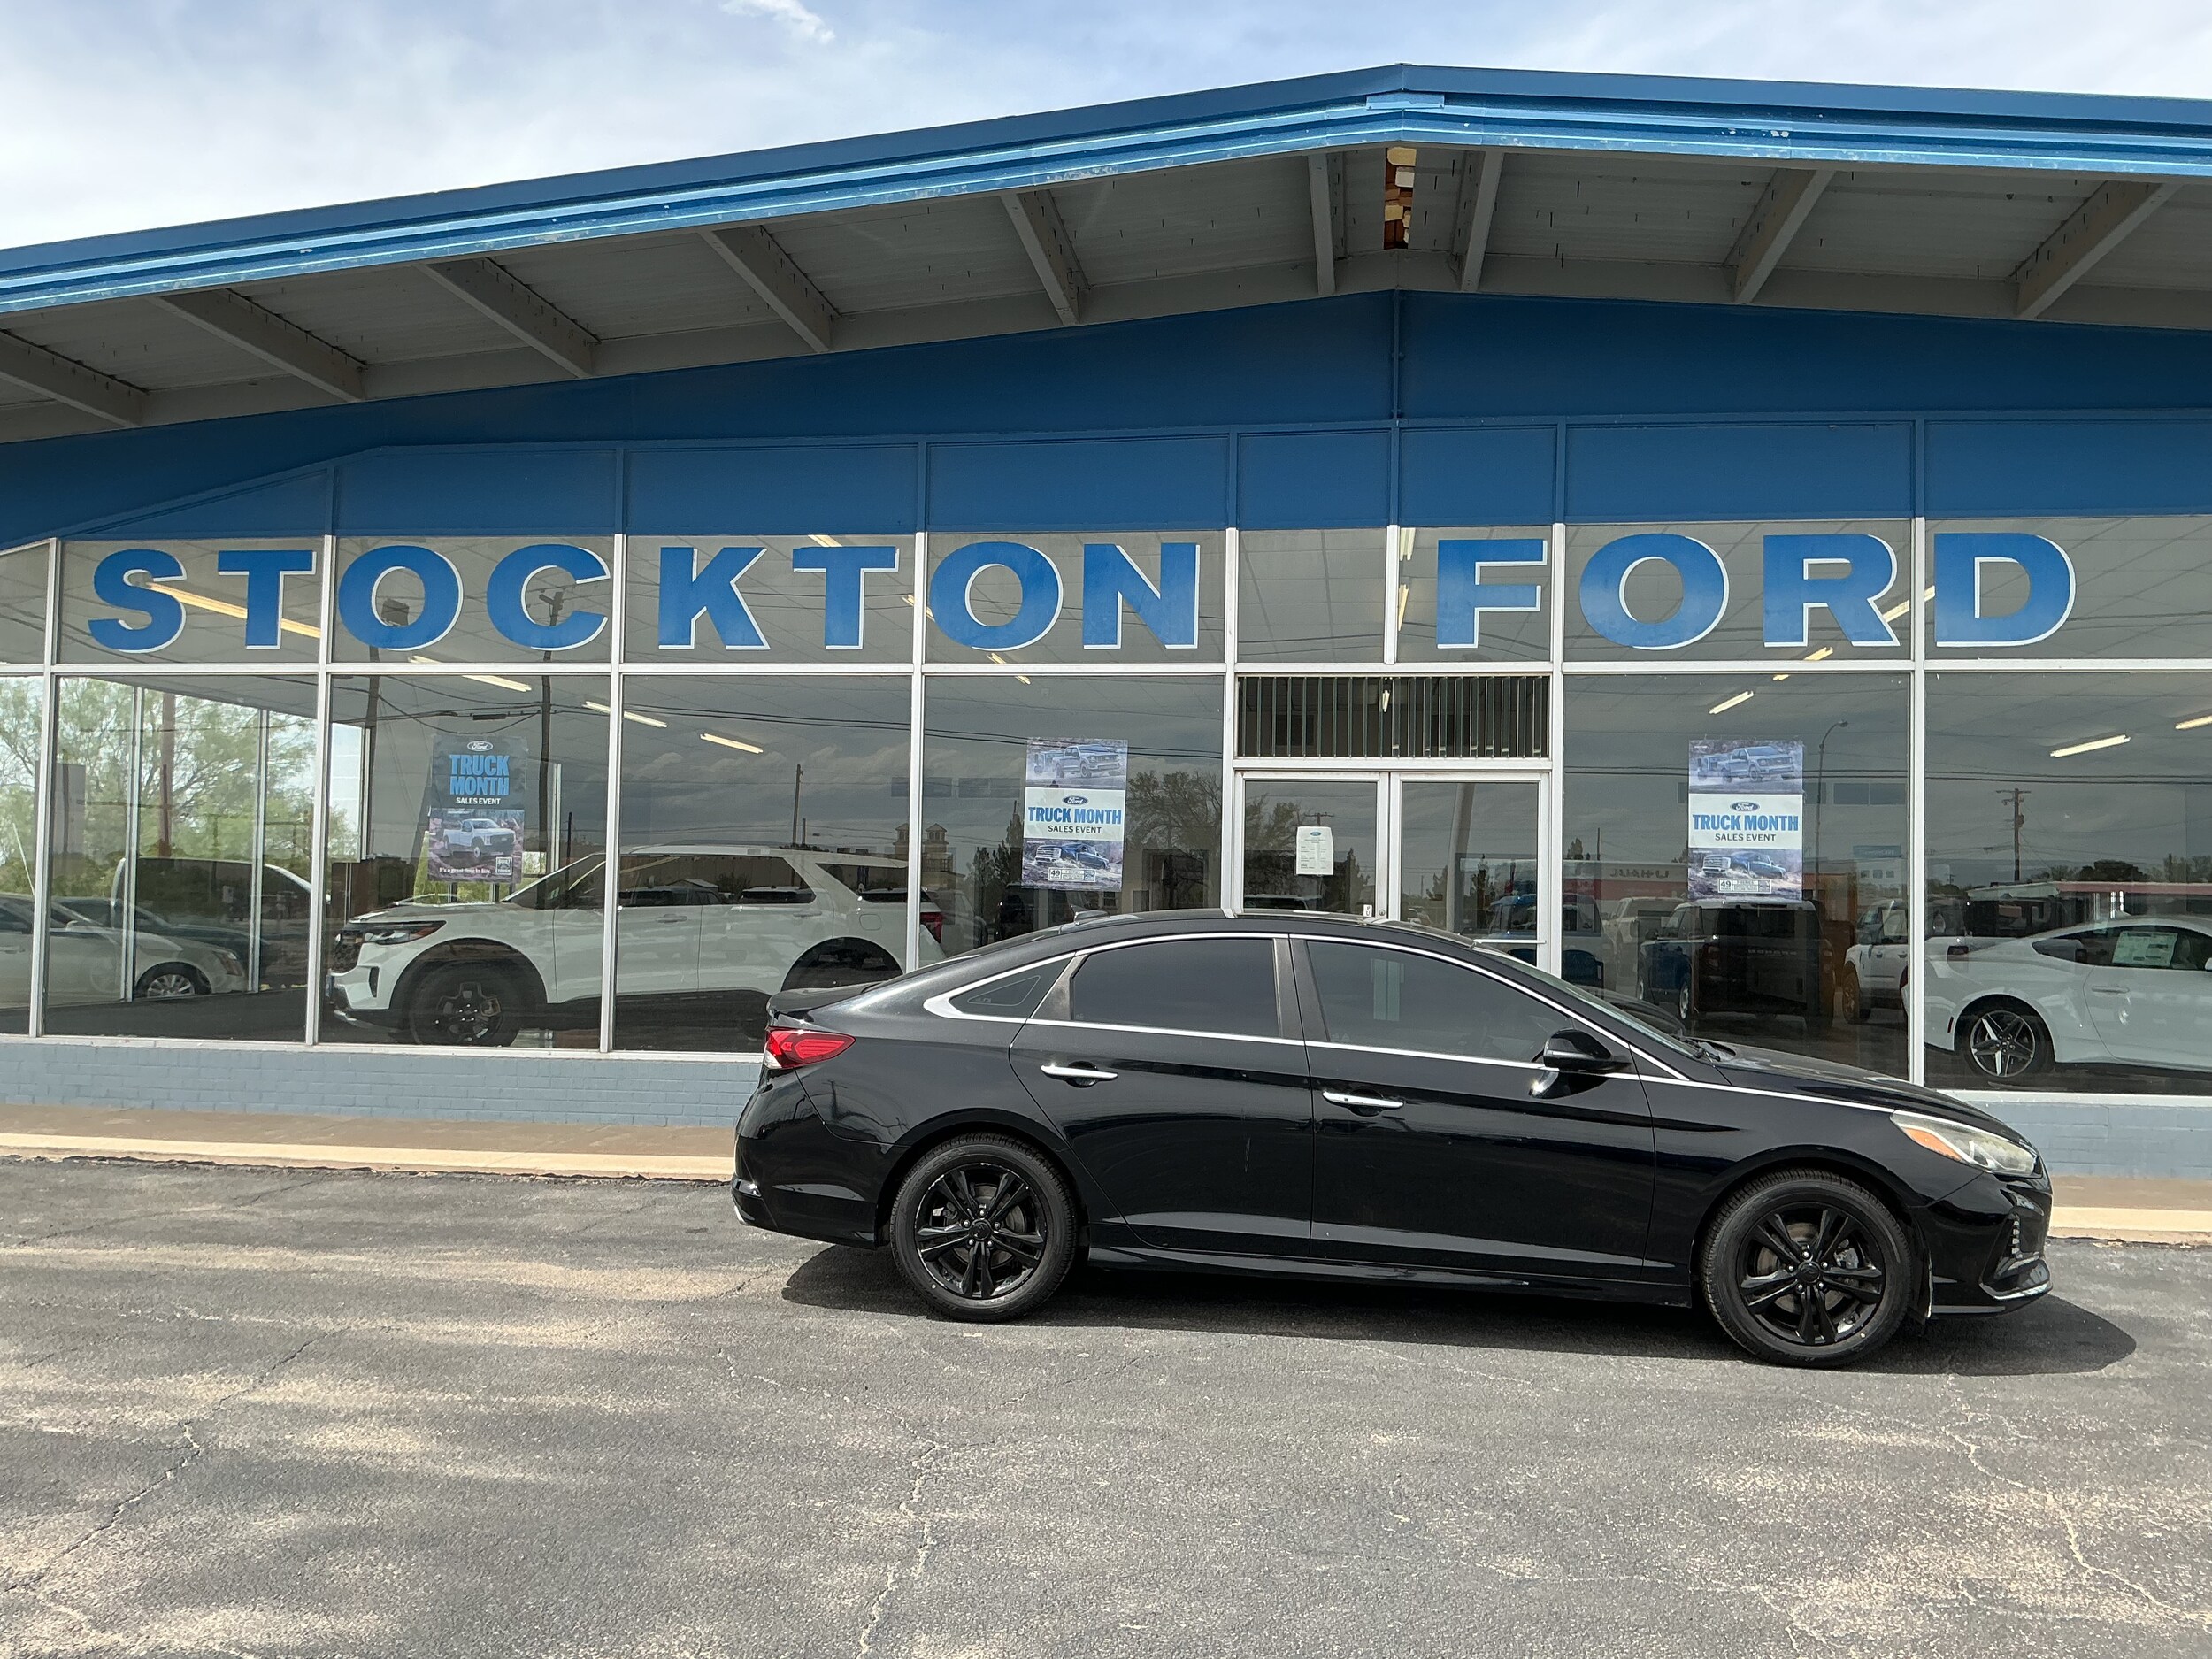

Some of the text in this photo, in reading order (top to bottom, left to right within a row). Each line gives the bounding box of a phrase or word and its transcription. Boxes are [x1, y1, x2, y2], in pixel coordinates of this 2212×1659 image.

[88, 534, 2077, 653] STOCKTON FORD
[449, 754, 510, 776] TRUCK
[449, 776, 510, 796] MONTH
[1028, 807, 1122, 825] TRUCK MONTH
[1693, 814, 1799, 832] TRUCK MONTH
